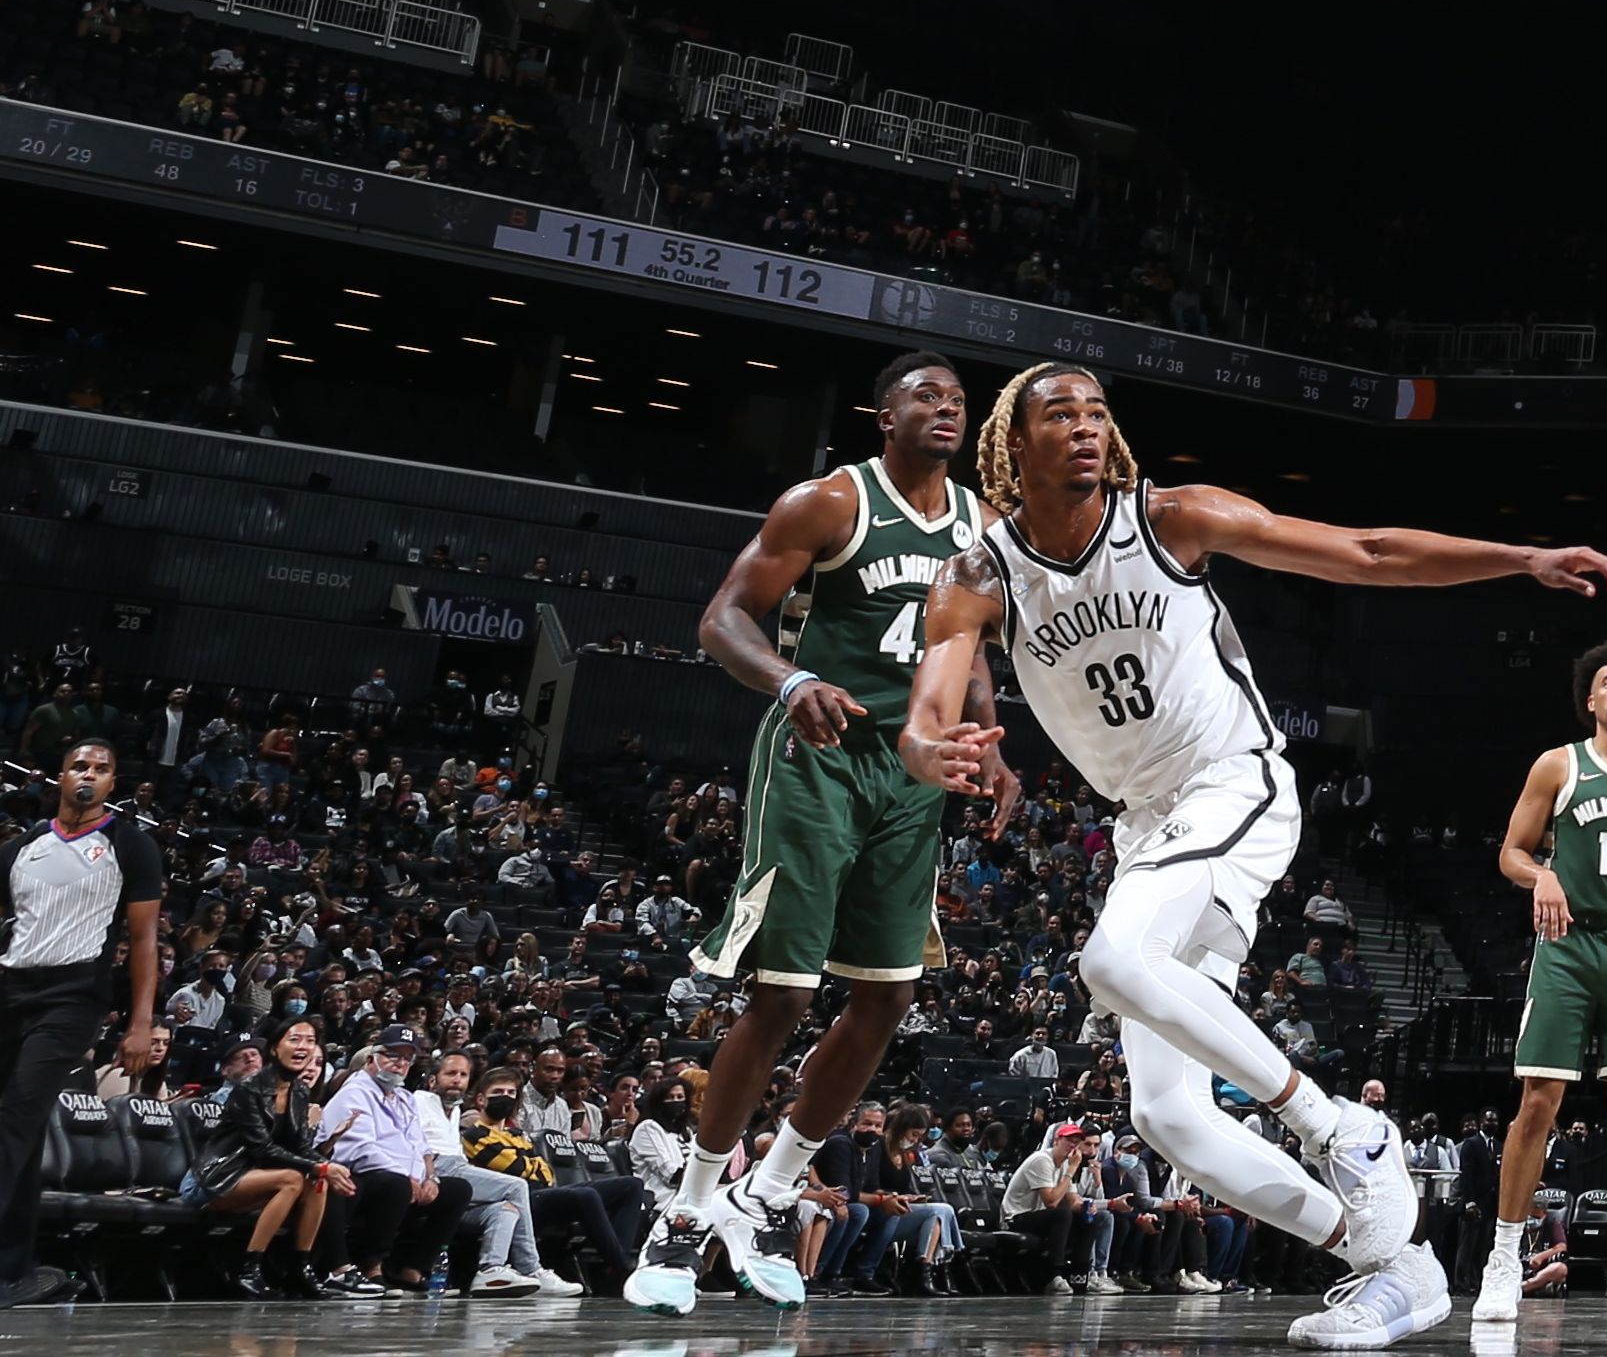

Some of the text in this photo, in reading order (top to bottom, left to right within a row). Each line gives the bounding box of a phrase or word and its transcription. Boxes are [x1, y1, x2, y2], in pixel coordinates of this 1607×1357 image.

[46, 118, 75, 135] FT
[19, 138, 45, 155] 20
[66, 146, 92, 163] 29
[150, 138, 194, 160] REB
[154, 163, 180, 181] 48
[227, 154, 271, 174] AST
[235, 178, 258, 195] 16
[352, 177, 365, 193] 3
[350, 202, 358, 216] 1
[563, 223, 630, 267] 111
[660, 240, 722, 272] 55.2
[644, 263, 731, 292] 4th Quarter
[753, 260, 822, 304] 112
[1008, 308, 1019, 321] 5
[1005, 330, 1016, 343] 2
[1071, 320, 1094, 337] FG
[1054, 337, 1072, 353] 43
[1086, 343, 1104, 358] 86
[1150, 335, 1177, 353] 3PT
[1135, 353, 1152, 367] 14
[1166, 358, 1184, 374] 38
[1231, 352, 1249, 367] FT
[1216, 368, 1231, 383] 12
[1246, 374, 1261, 389] 18
[1298, 365, 1329, 383] REB
[1302, 385, 1320, 400] 36
[1349, 376, 1379, 393] AST
[1352, 395, 1369, 410] 27
[109, 479, 141, 496] LG2
[268, 565, 352, 589] LOGE BOX
[117, 615, 142, 630] 28
[424, 597, 524, 641] Modelo
[879, 601, 927, 664] 4
[1026, 591, 1170, 669] BROOKLYN
[1085, 653, 1155, 728] 33
[59, 1093, 105, 1111] QATAR
[129, 1098, 172, 1117] QATAR
[191, 1102, 225, 1119] QATA
